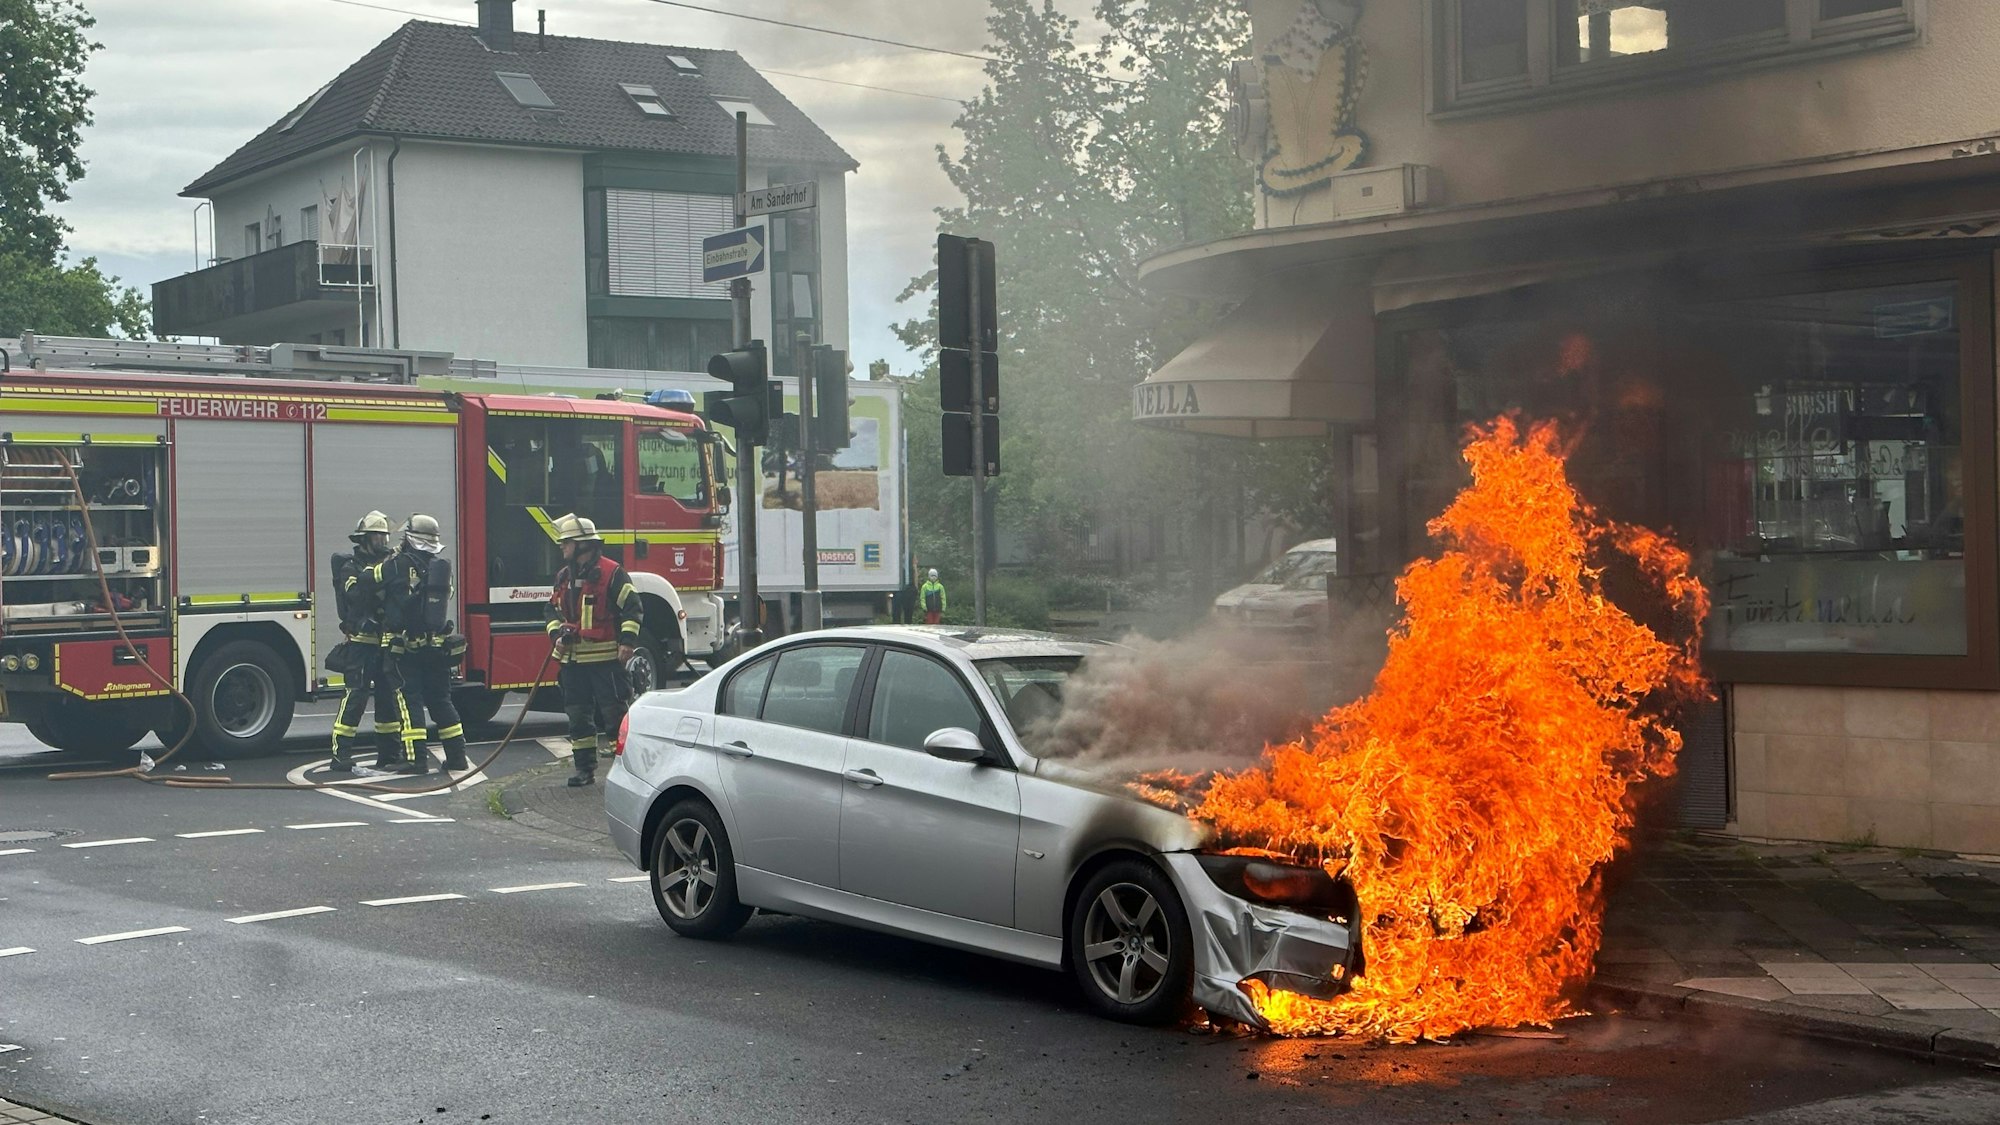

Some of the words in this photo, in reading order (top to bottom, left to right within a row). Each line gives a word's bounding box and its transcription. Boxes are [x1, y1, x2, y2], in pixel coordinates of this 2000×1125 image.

[750, 196, 763, 210] Am
[766, 187, 807, 208] Sanderhof
[706, 246, 748, 264] Einbahnstraße
[157, 398, 279, 418] FEUERWEHR
[300, 403, 327, 419] 112
[1135, 384, 1200, 417] NELLA
[103, 682, 151, 692] Schlingmann
